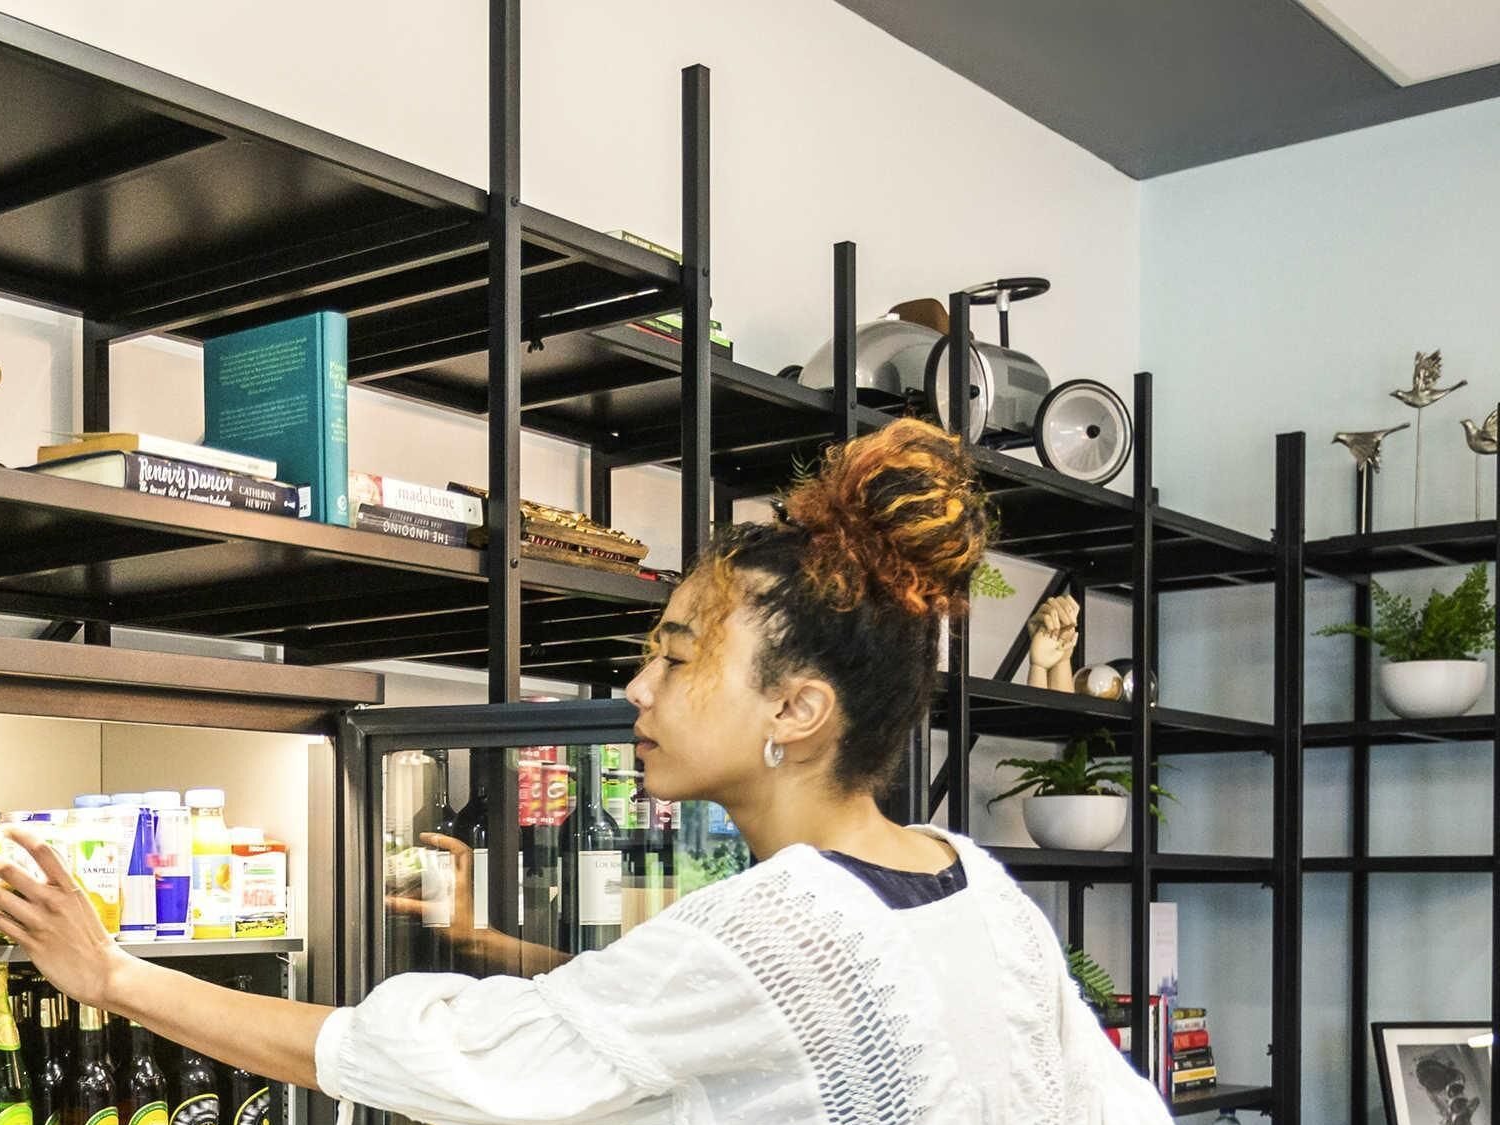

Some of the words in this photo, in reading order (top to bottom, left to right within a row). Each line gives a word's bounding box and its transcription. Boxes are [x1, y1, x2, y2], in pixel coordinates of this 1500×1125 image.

[238, 485, 277, 502] CATHERINE
[244, 496, 272, 512] HEWITT
[382, 520, 430, 541] UNDOING
[432, 530, 449, 546] THE
